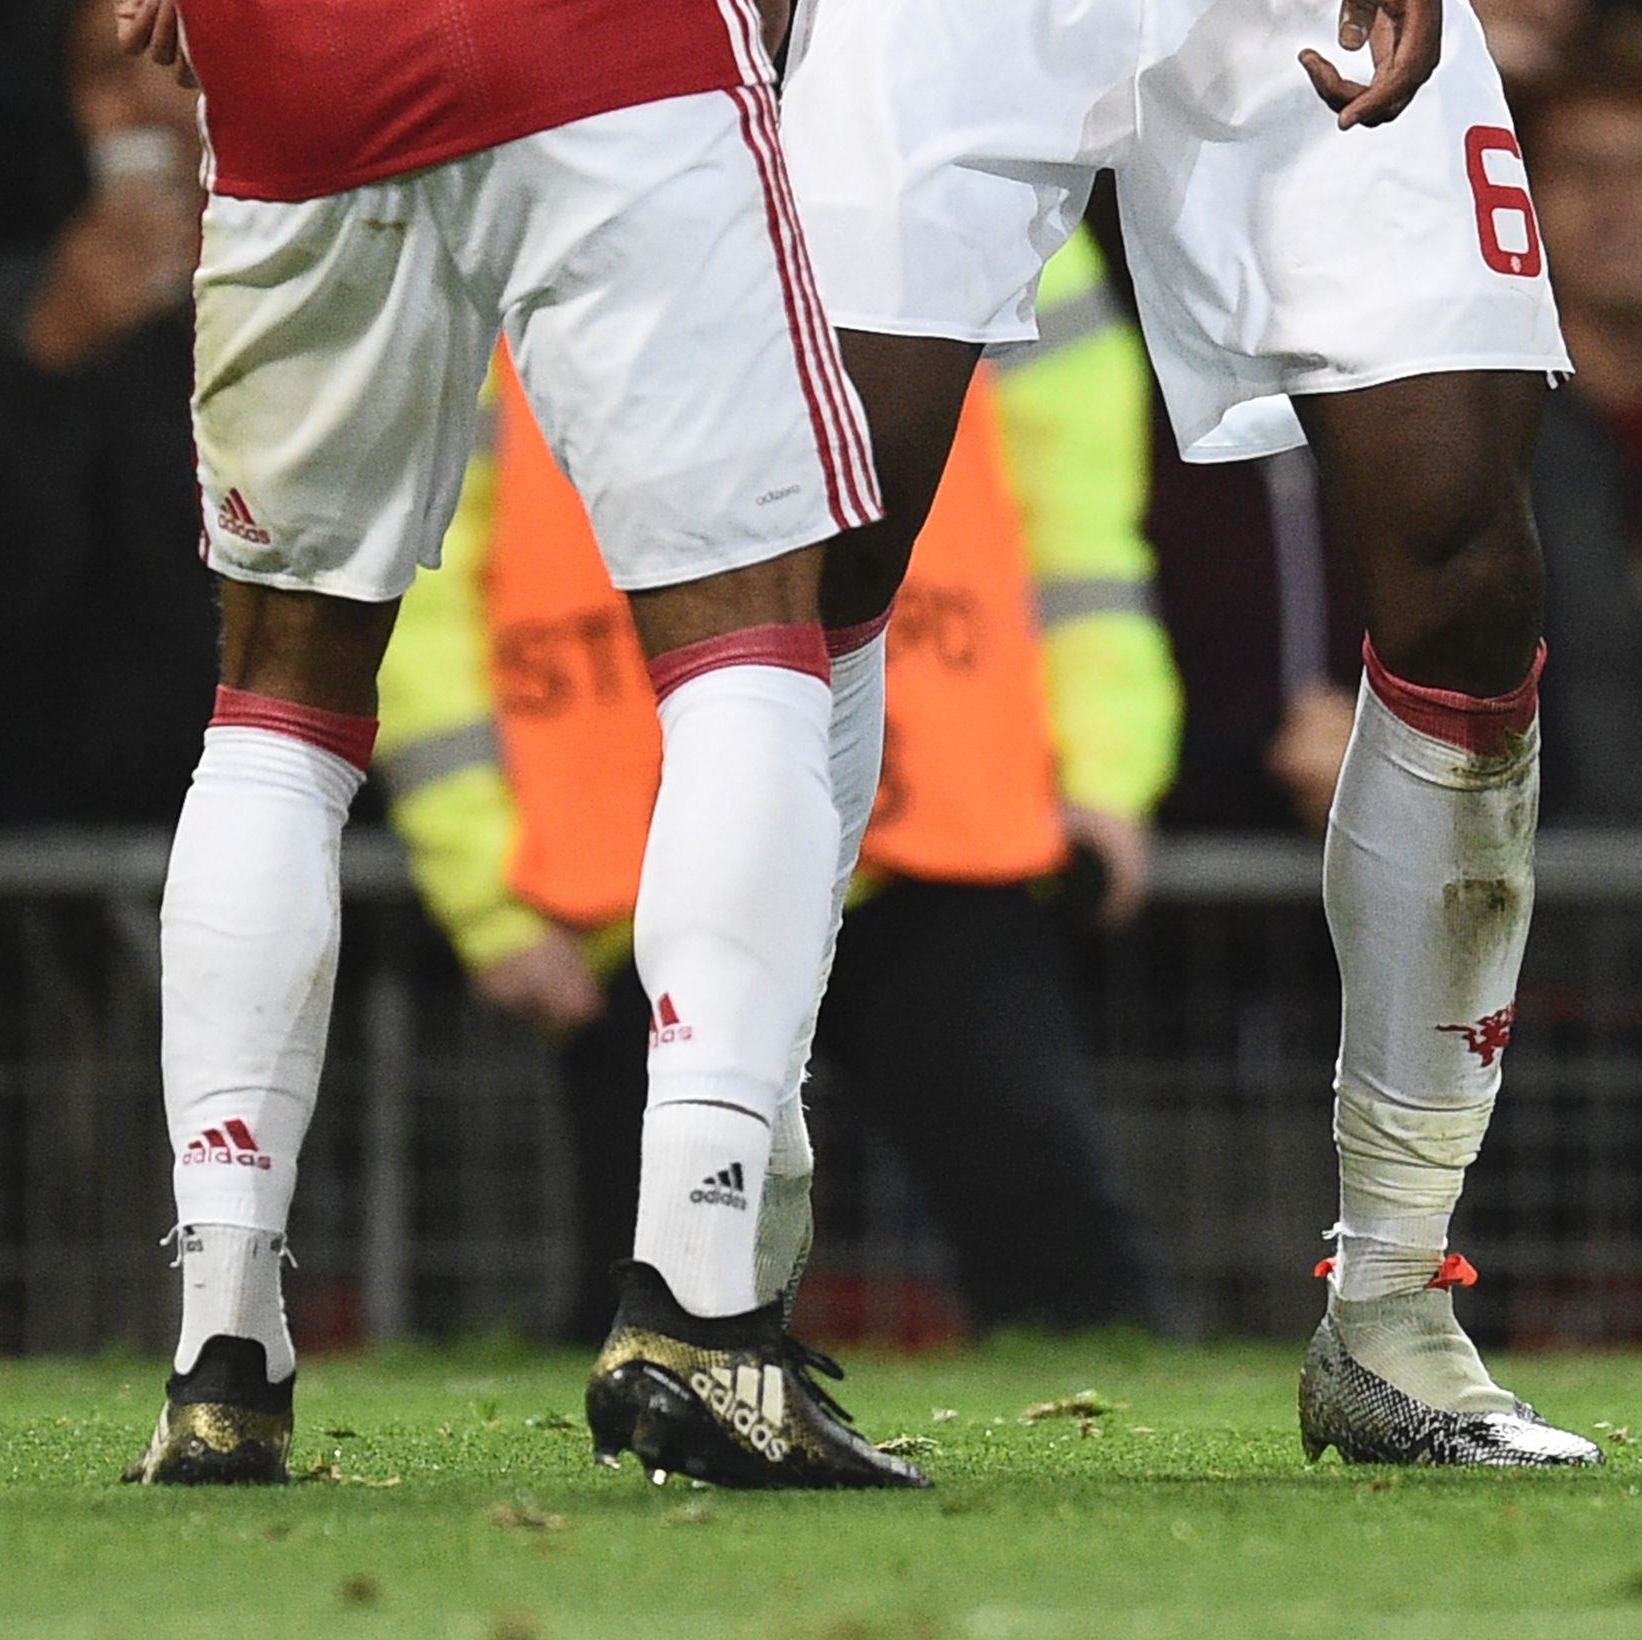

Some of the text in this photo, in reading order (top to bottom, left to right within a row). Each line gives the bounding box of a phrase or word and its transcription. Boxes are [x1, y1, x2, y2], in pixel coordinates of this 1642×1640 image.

[1464, 124, 1542, 278] 6
[182, 1145, 271, 1171] adidas
[689, 1188, 748, 1212] adidas
[690, 1371, 790, 1463] adidas
